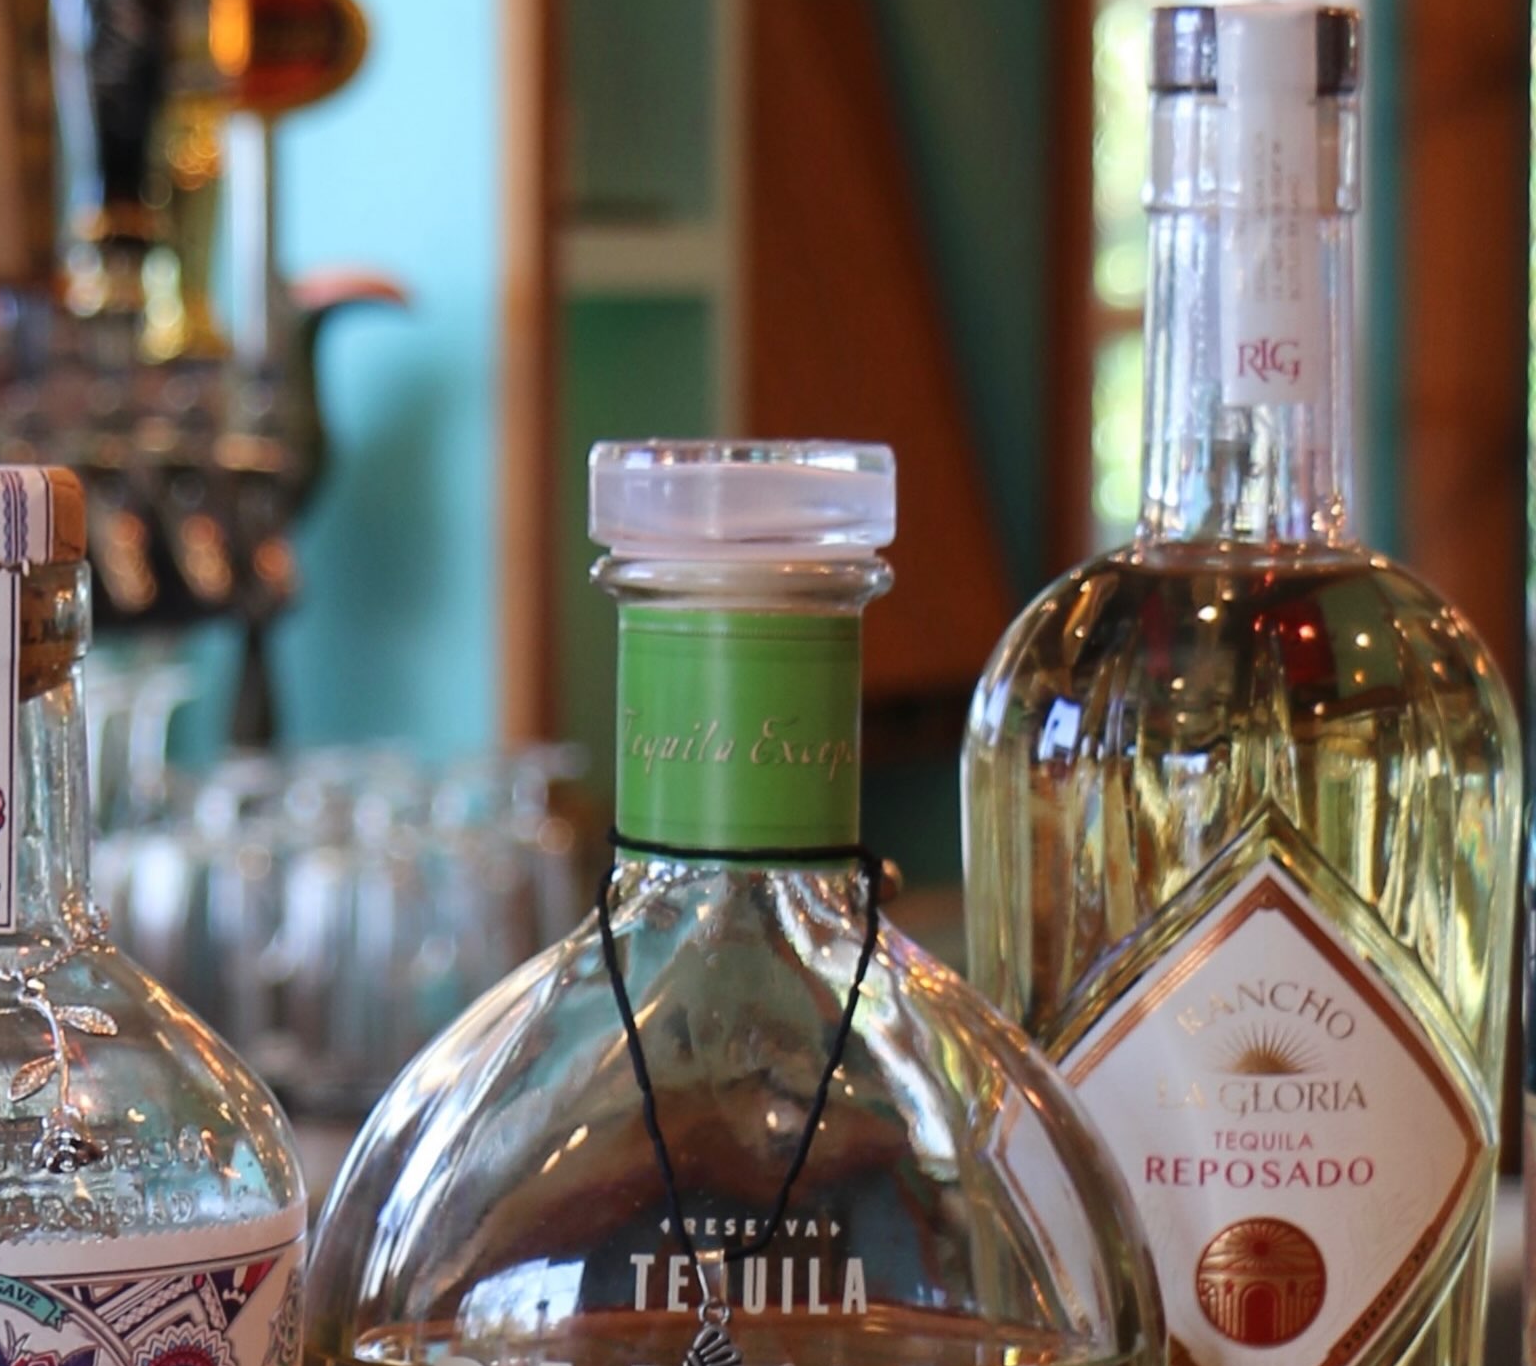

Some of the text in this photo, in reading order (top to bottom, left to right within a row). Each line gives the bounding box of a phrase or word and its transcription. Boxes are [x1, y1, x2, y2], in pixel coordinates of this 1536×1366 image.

[1175, 979, 1356, 1041] RANCHO
[1219, 1081, 1368, 1118] GLORIA
[1214, 1131, 1314, 1152] TEQUILA
[1144, 1155, 1376, 1189] REPOSADO
[683, 1217, 819, 1239] RESEVA
[630, 1253, 868, 1315] TEUILA
